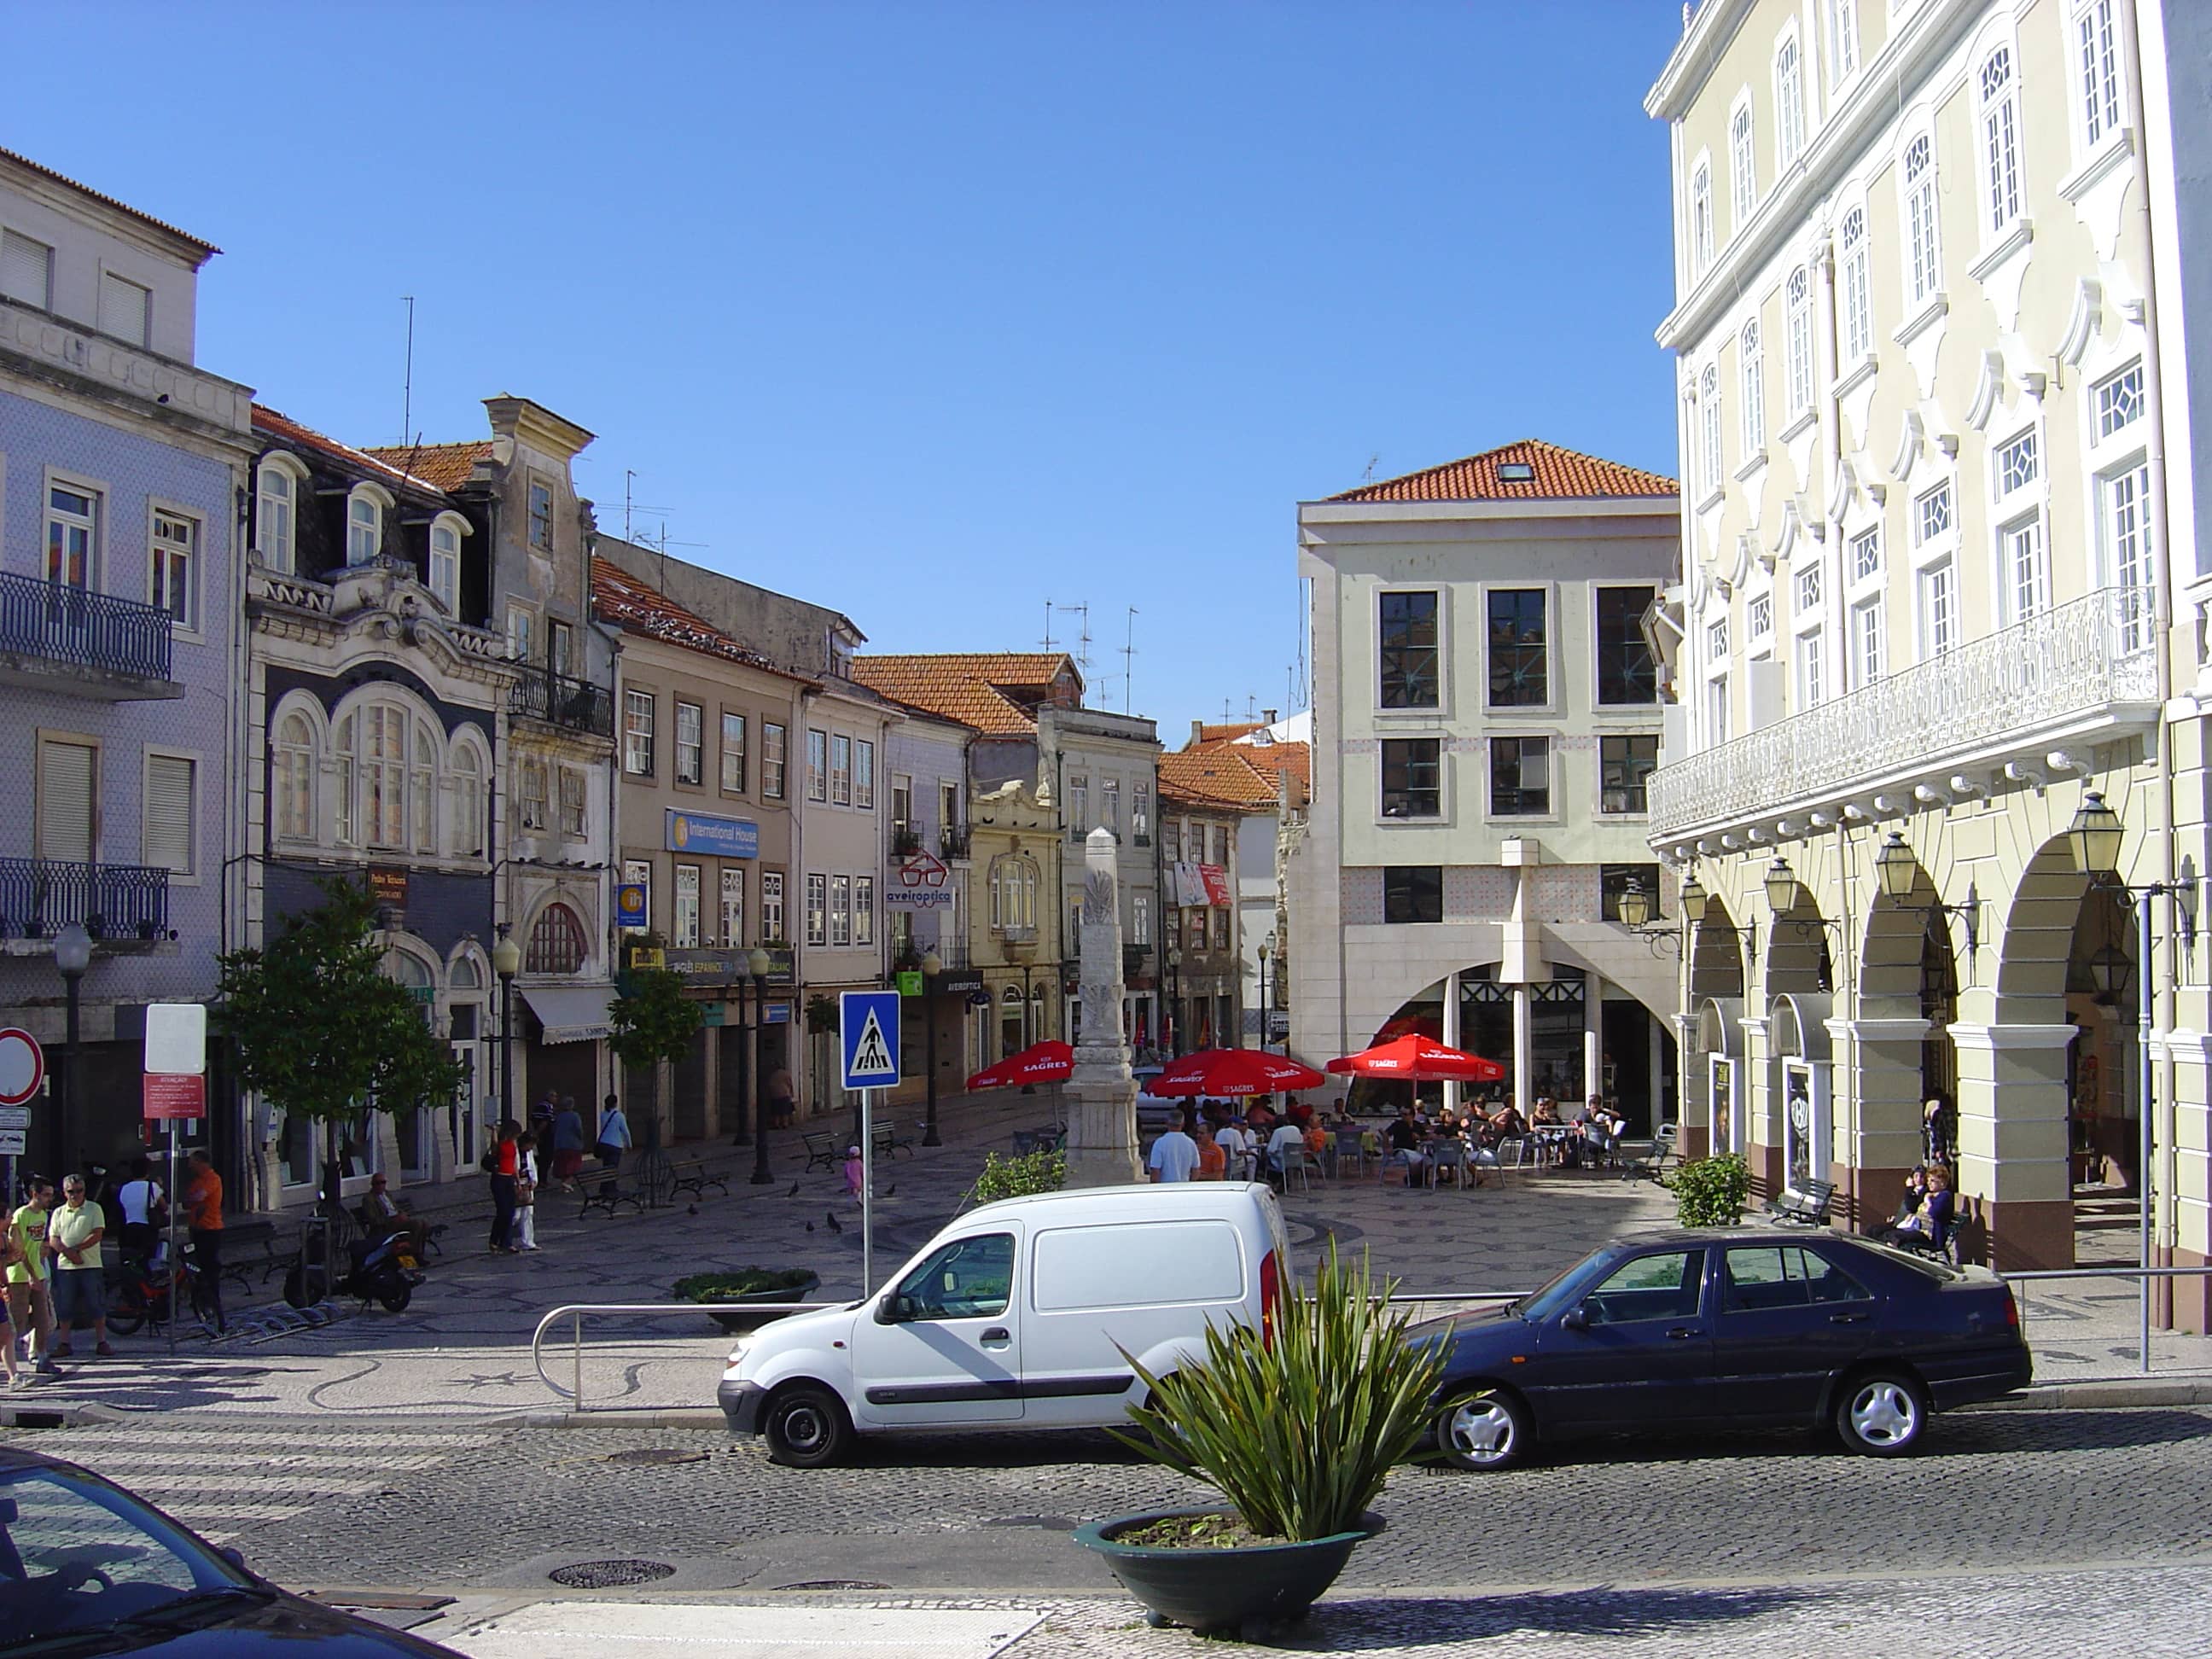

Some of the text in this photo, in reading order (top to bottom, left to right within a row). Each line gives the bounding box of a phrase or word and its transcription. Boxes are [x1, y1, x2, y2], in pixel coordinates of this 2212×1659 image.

[689, 821, 757, 843] International House
[887, 889, 950, 902] aveiroptica
[1023, 1061, 1068, 1072] SAGRES
[1375, 1059, 1399, 1068] SAGRES
